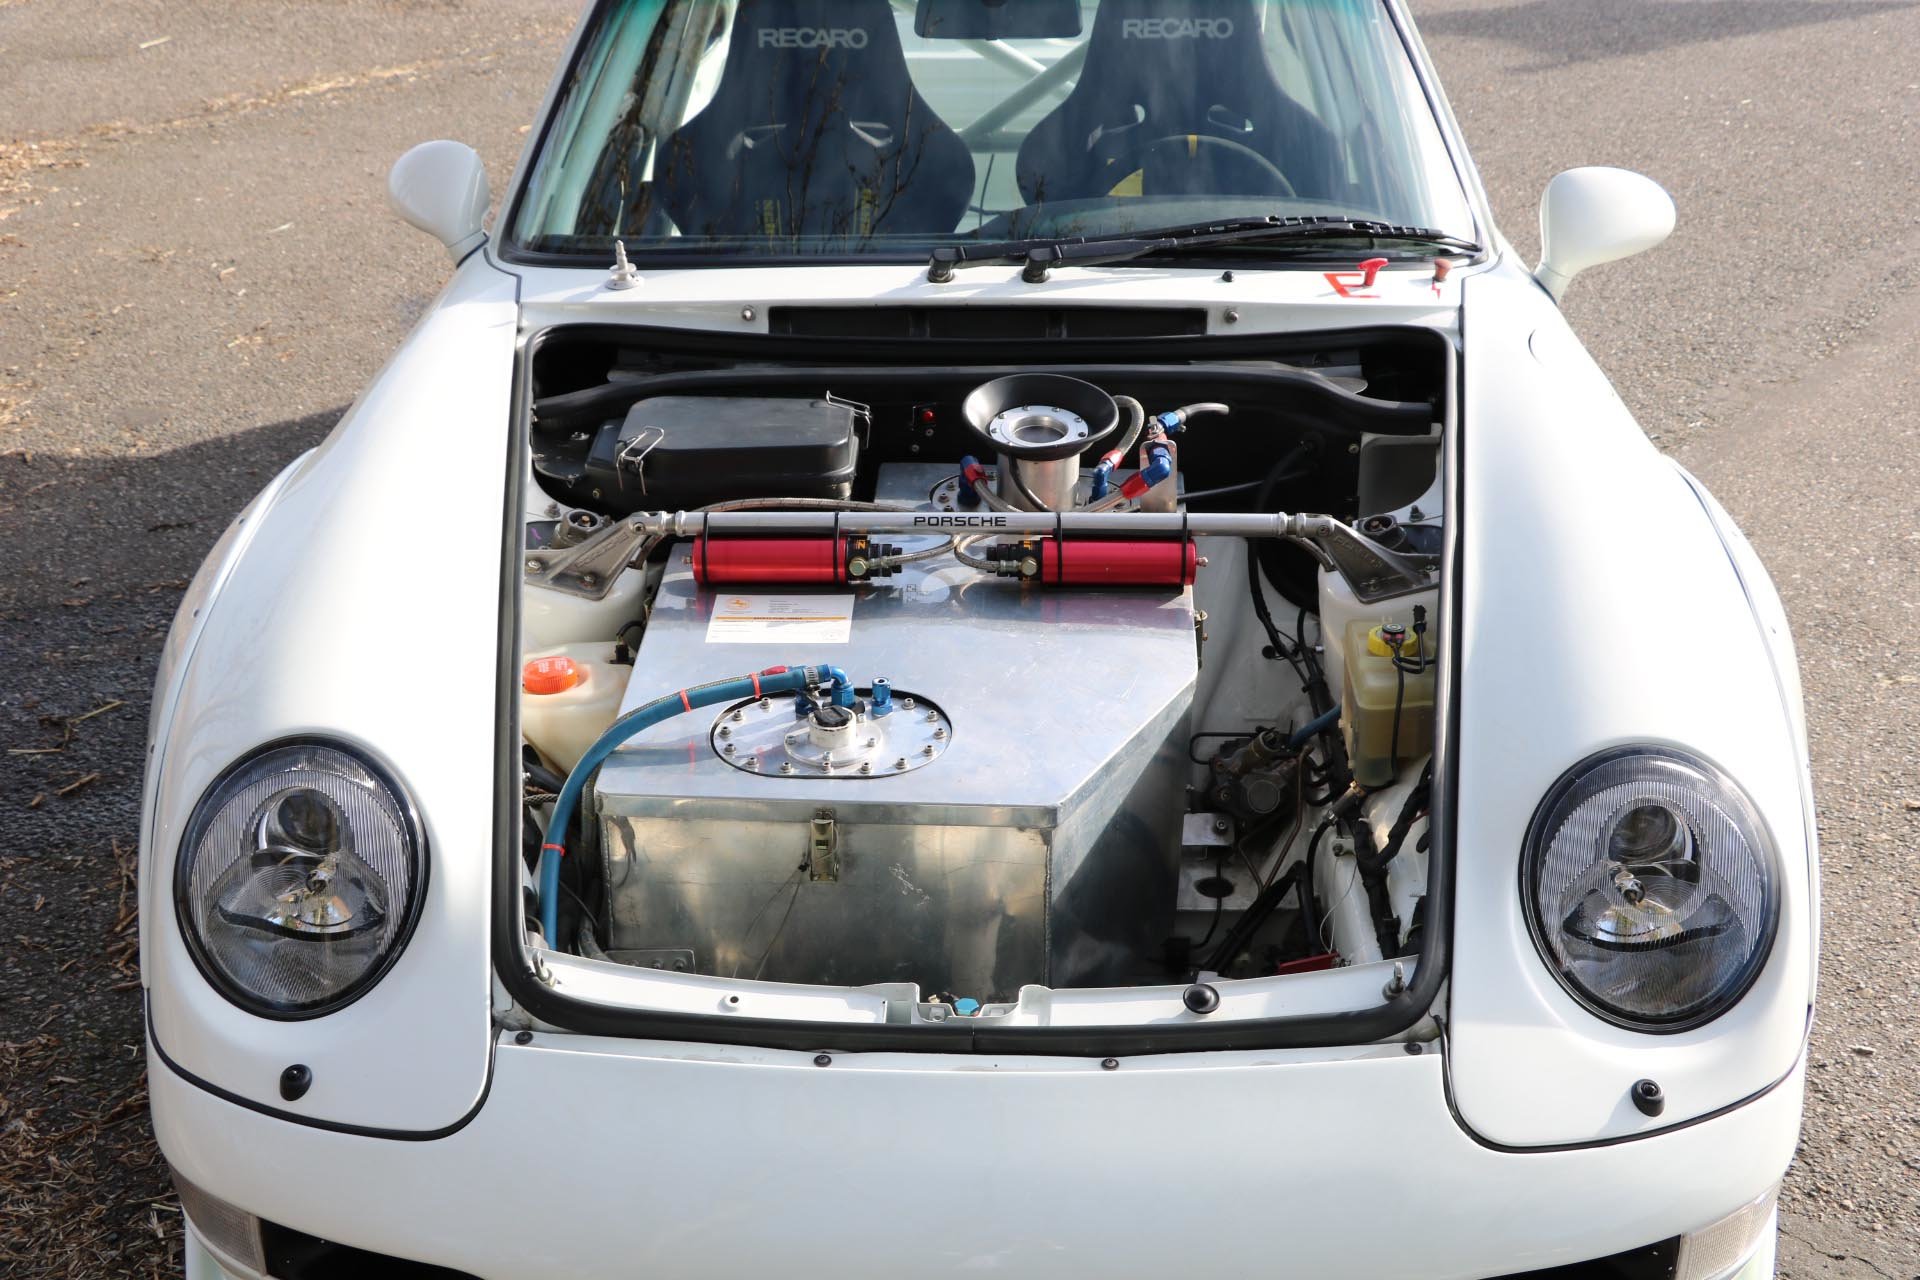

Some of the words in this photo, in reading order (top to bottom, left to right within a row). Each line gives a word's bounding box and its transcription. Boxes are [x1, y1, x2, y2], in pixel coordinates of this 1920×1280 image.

[758, 27, 868, 49] RECARO
[1122, 18, 1234, 40] RECARO
[913, 516, 1007, 527] PORSCHE
